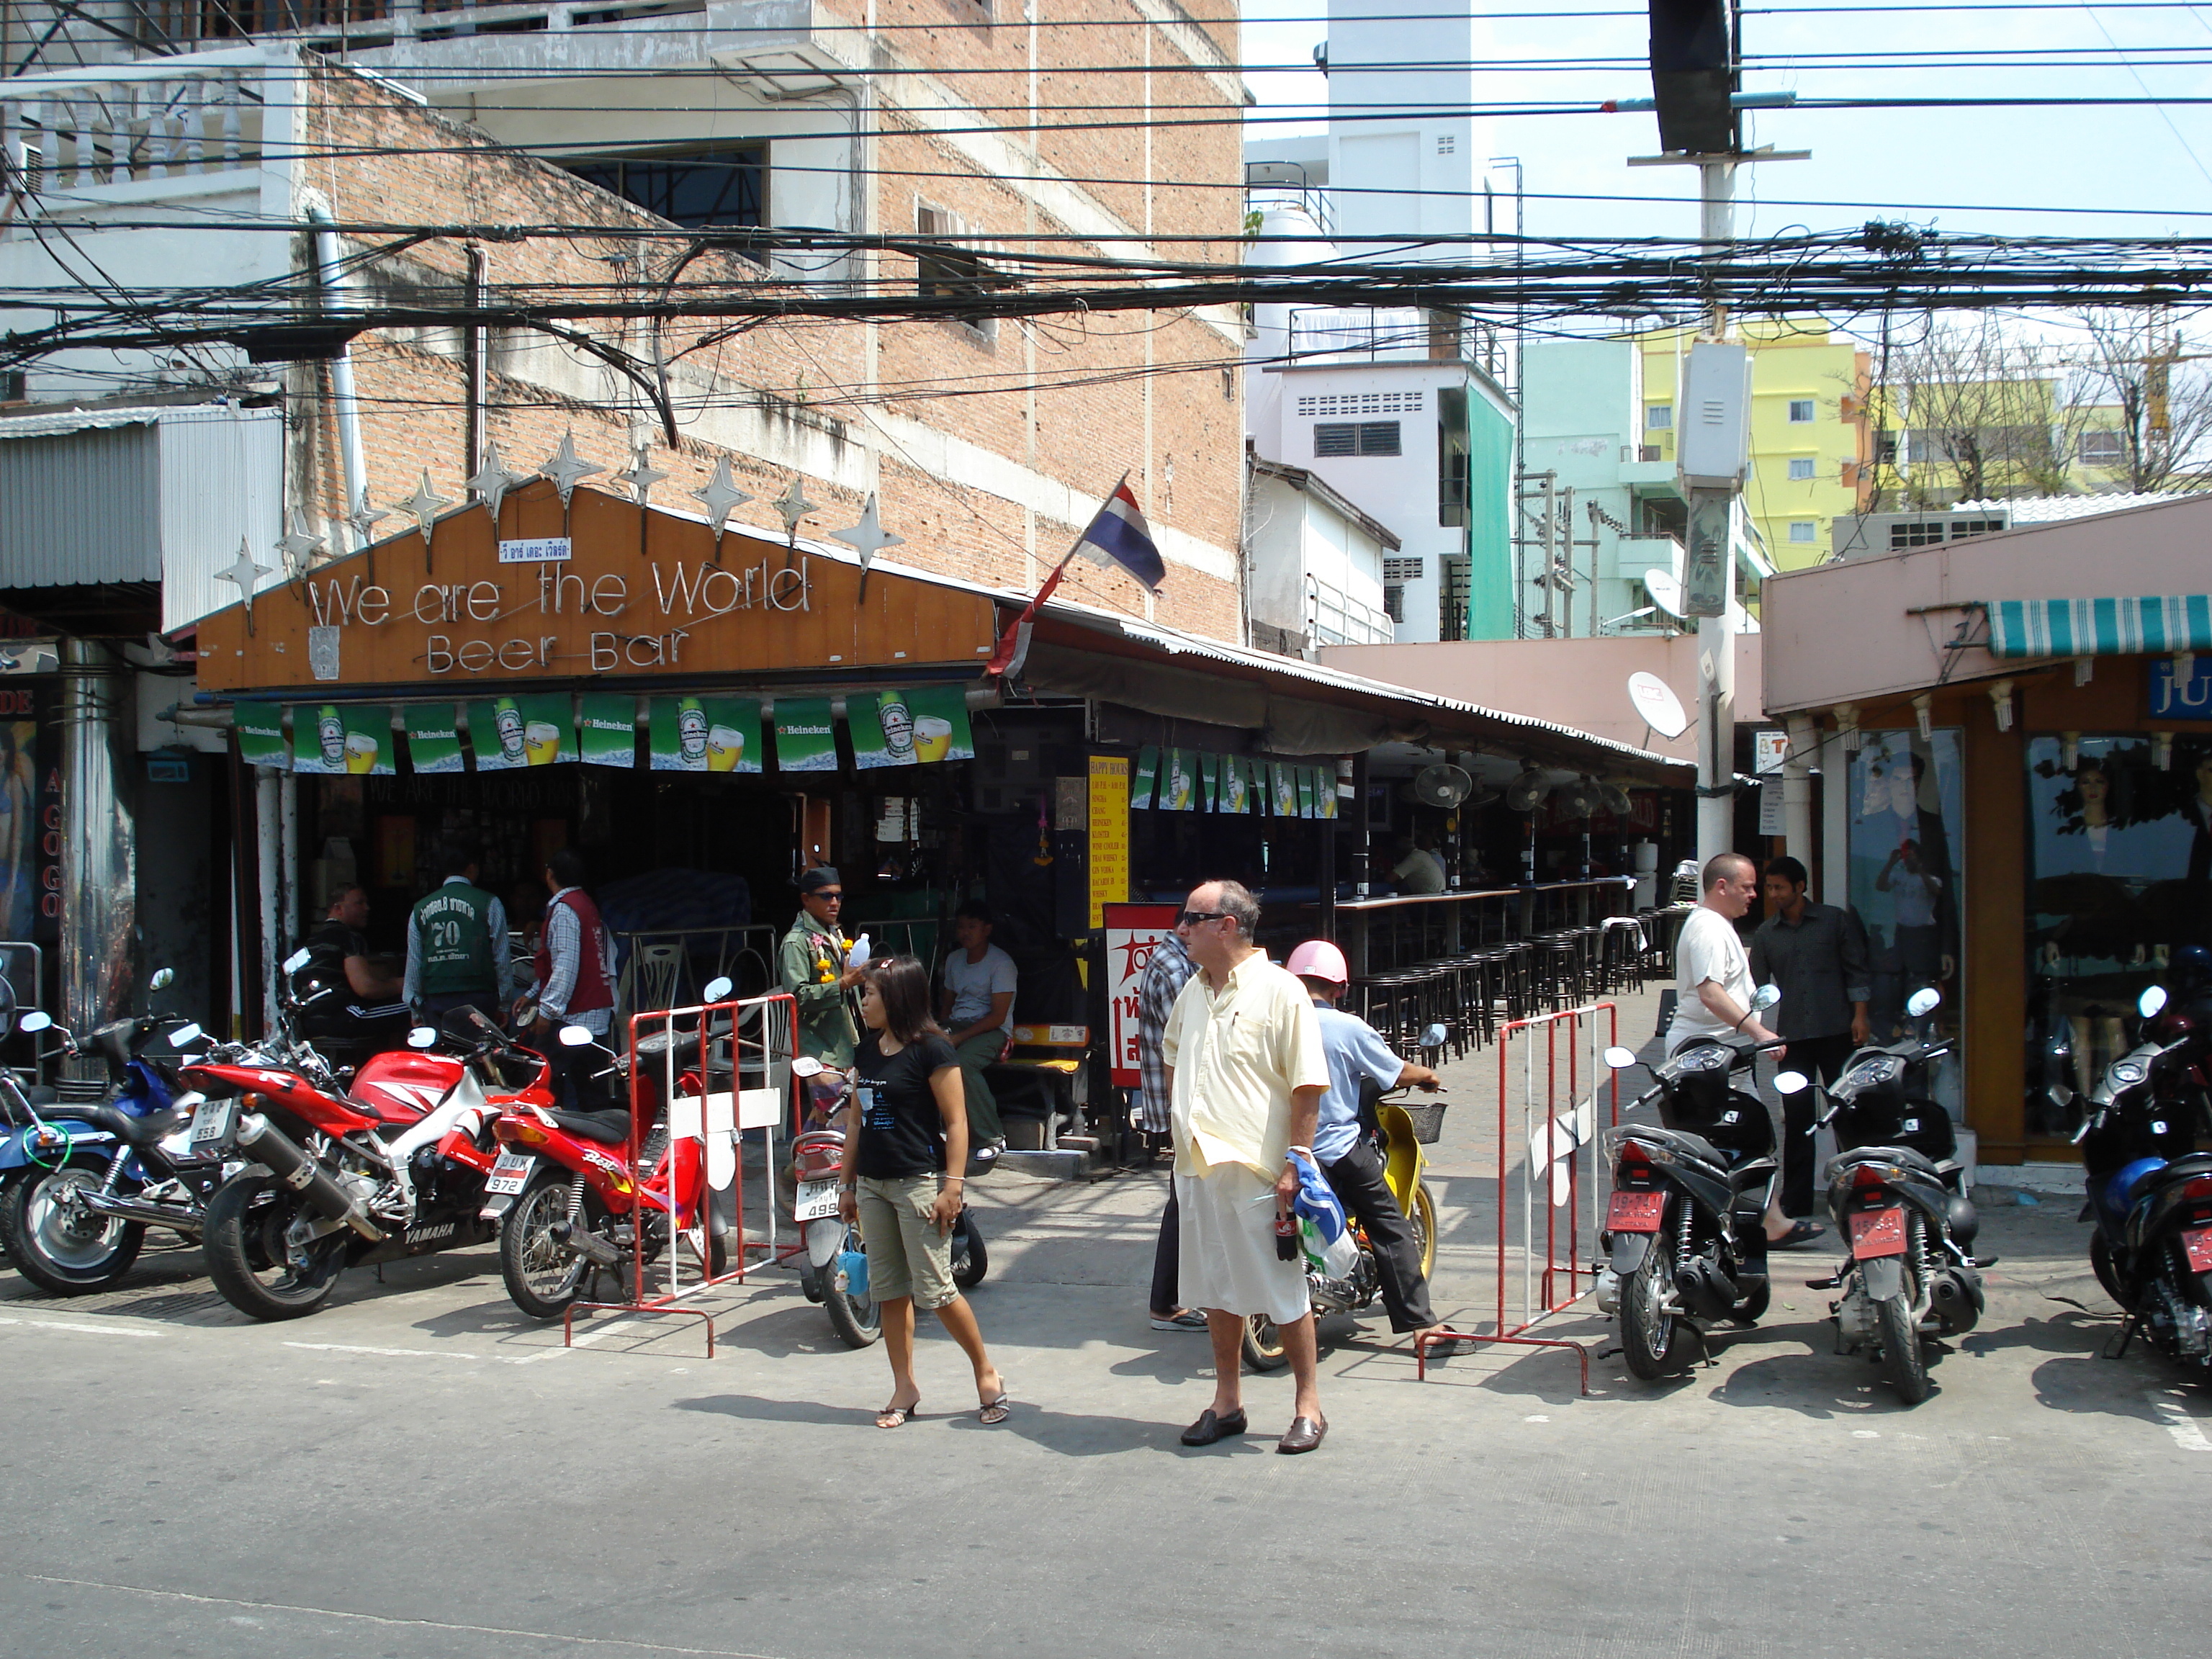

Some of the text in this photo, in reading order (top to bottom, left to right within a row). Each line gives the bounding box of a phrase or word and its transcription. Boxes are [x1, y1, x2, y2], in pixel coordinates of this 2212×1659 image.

[308, 556, 810, 627] We are the World
[428, 631, 689, 674] Beer Bar
[245, 725, 281, 737] Heineken
[592, 718, 634, 732] Heineken
[786, 724, 831, 735] Heineken
[417, 729, 457, 739] Heineken
[1091, 761, 1107, 775] HAPPY
[1110, 762, 1128, 775] HOURS
[431, 920, 461, 947] 70
[582, 1148, 619, 1171] Best
[492, 1179, 518, 1192] 972
[808, 1202, 837, 1217] 499
[405, 1222, 455, 1245] YAMAHA
